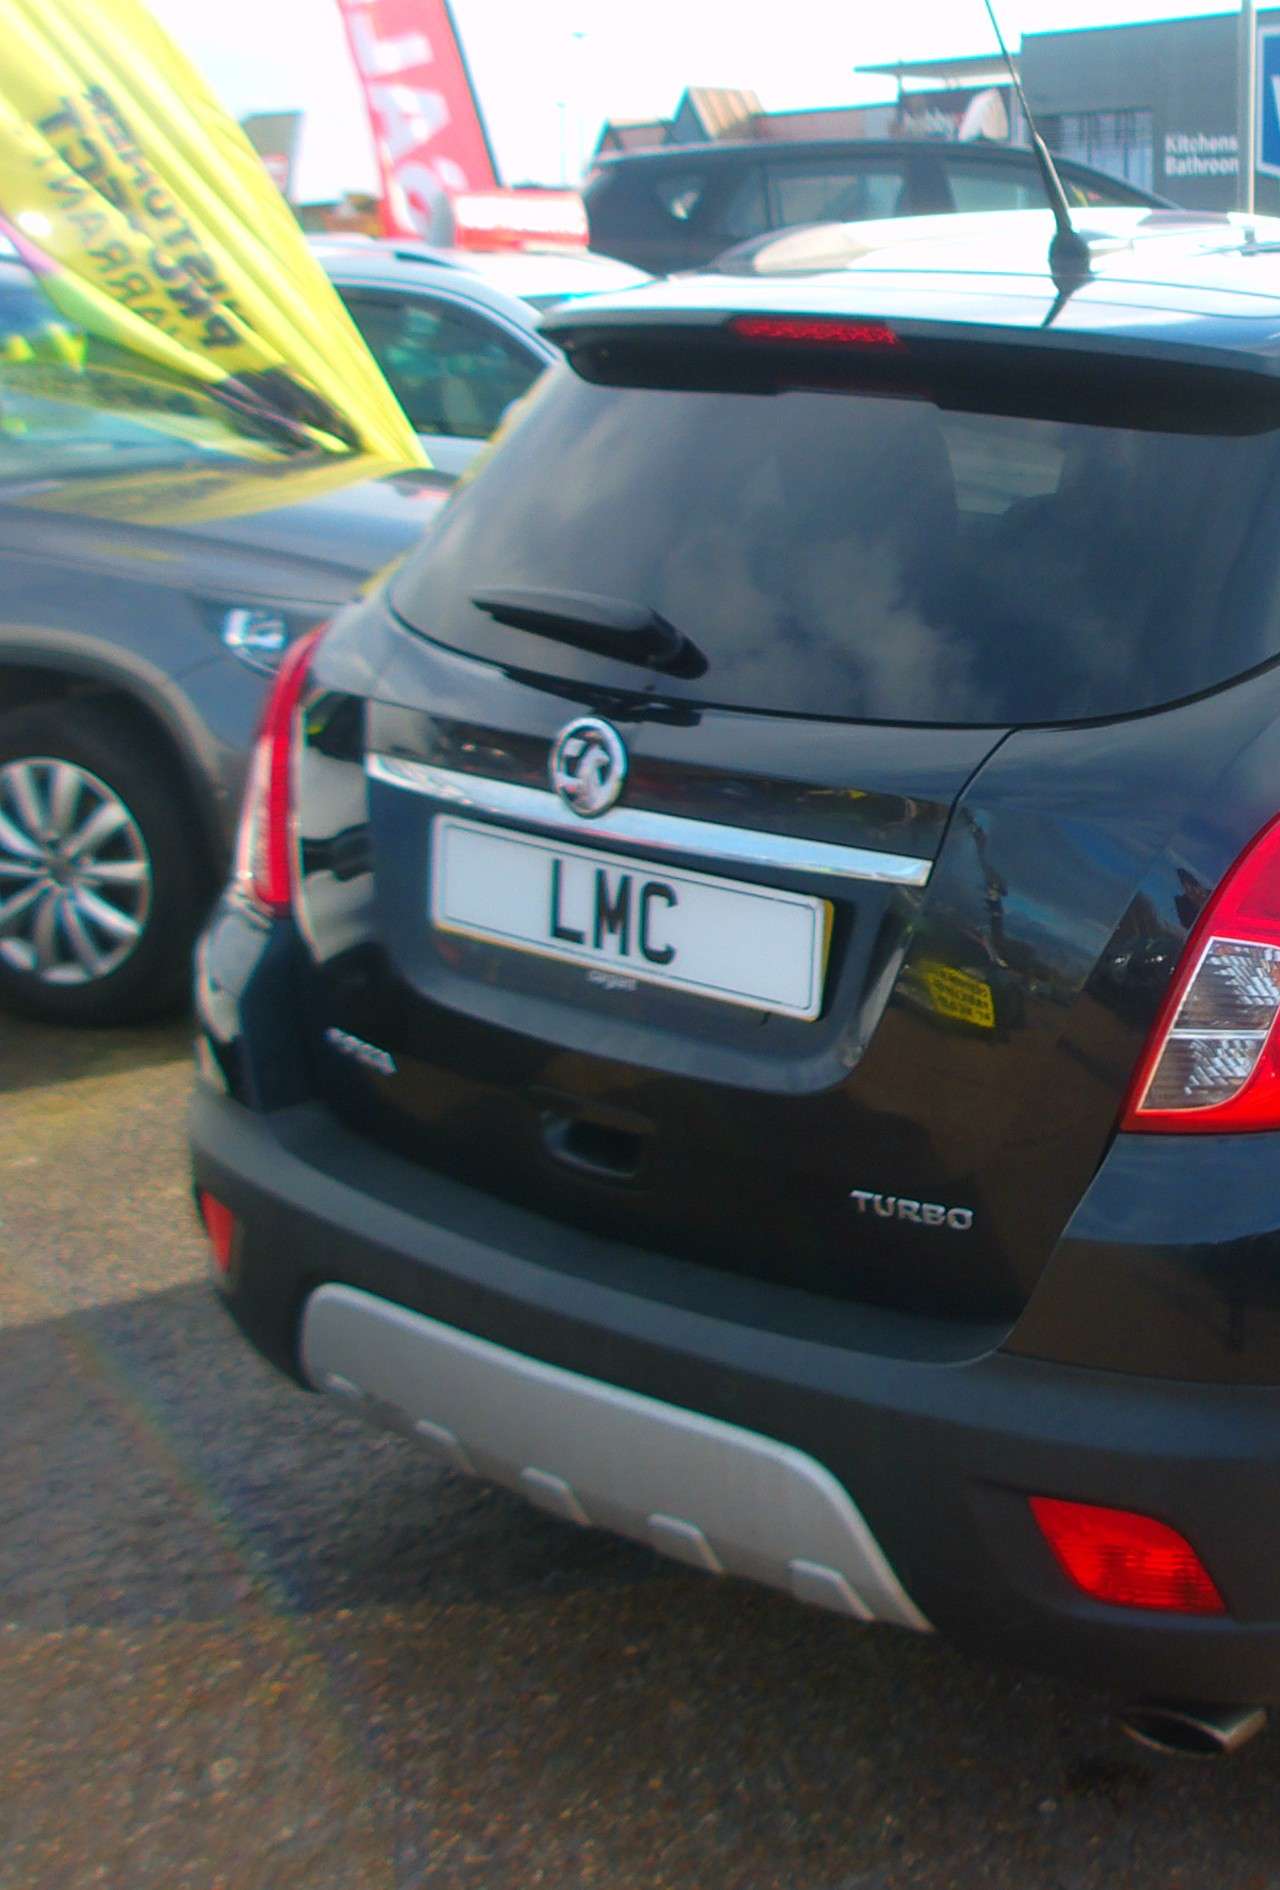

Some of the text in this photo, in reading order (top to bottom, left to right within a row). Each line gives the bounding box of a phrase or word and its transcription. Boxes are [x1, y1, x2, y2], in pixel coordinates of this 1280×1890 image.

[1165, 132, 1239, 153] Kitchens
[551, 859, 678, 965] LMC
[850, 1190, 973, 1230] TURBO
